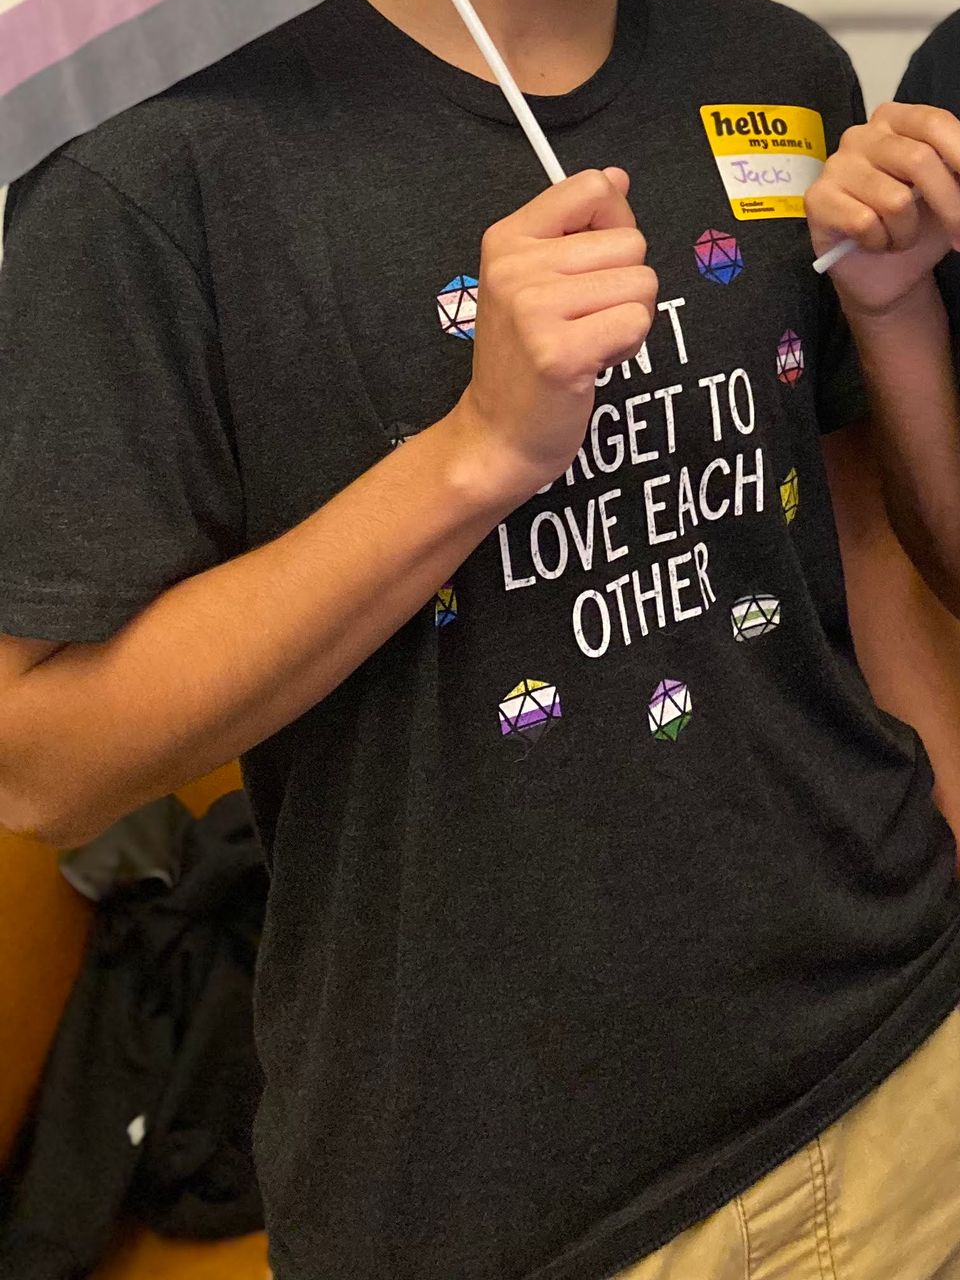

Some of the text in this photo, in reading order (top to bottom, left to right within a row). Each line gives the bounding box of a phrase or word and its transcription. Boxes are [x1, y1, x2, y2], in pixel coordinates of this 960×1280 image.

[711, 111, 788, 137] hello
[749, 138, 812, 150] my name is
[698, 368, 755, 441] TO
[498, 448, 764, 591] LOVE EACH
[573, 542, 716, 658] OTHER
